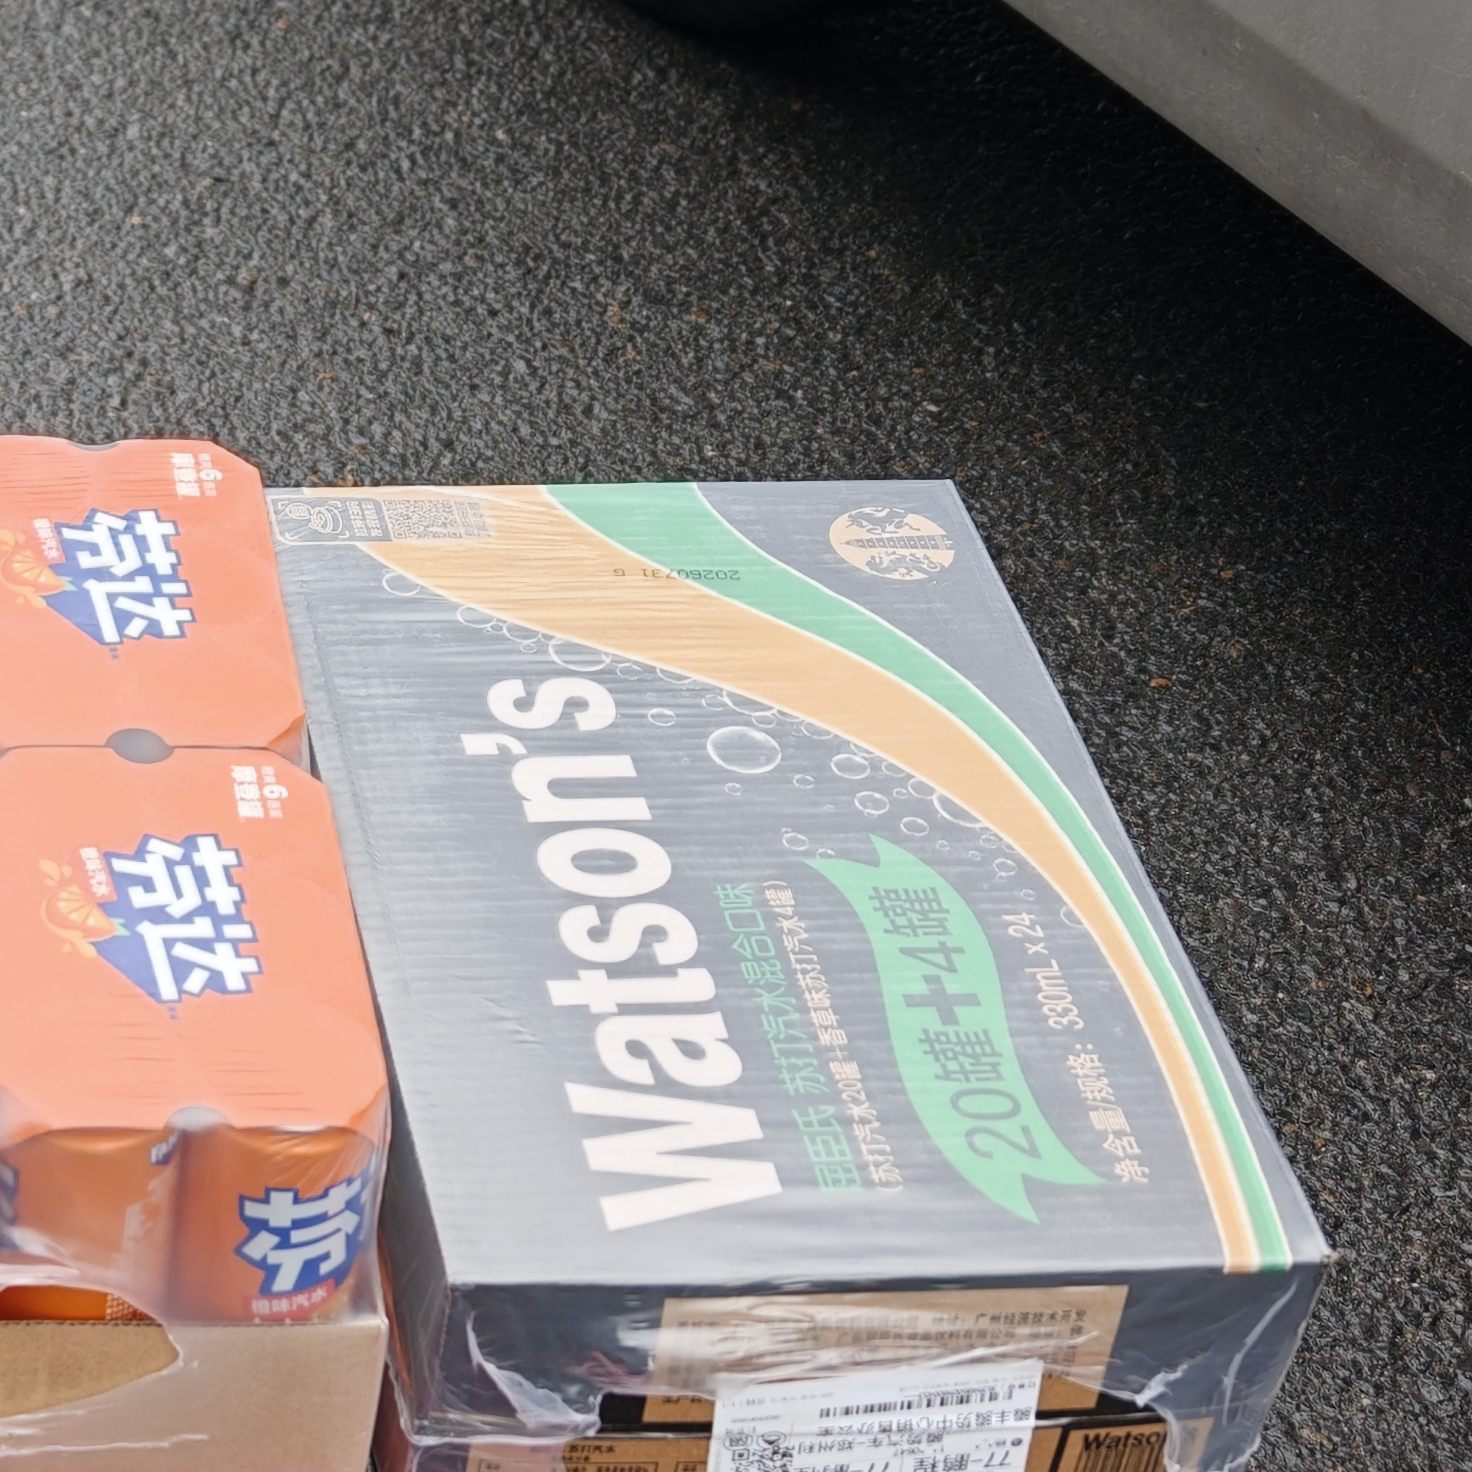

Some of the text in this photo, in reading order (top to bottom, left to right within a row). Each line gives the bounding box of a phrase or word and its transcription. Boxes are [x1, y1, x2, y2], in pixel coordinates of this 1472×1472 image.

[59, 510, 193, 643] 芬达
[110, 835, 259, 1001] 芬达
[459, 676, 783, 1232] Watson's
[1007, 911, 1045, 940] 24
[713, 880, 864, 1192] 屈臣氏 苏打汽水混合口味
[1025, 959, 1085, 1030] 330mL
[1083, 1430, 1164, 1452] Watso
